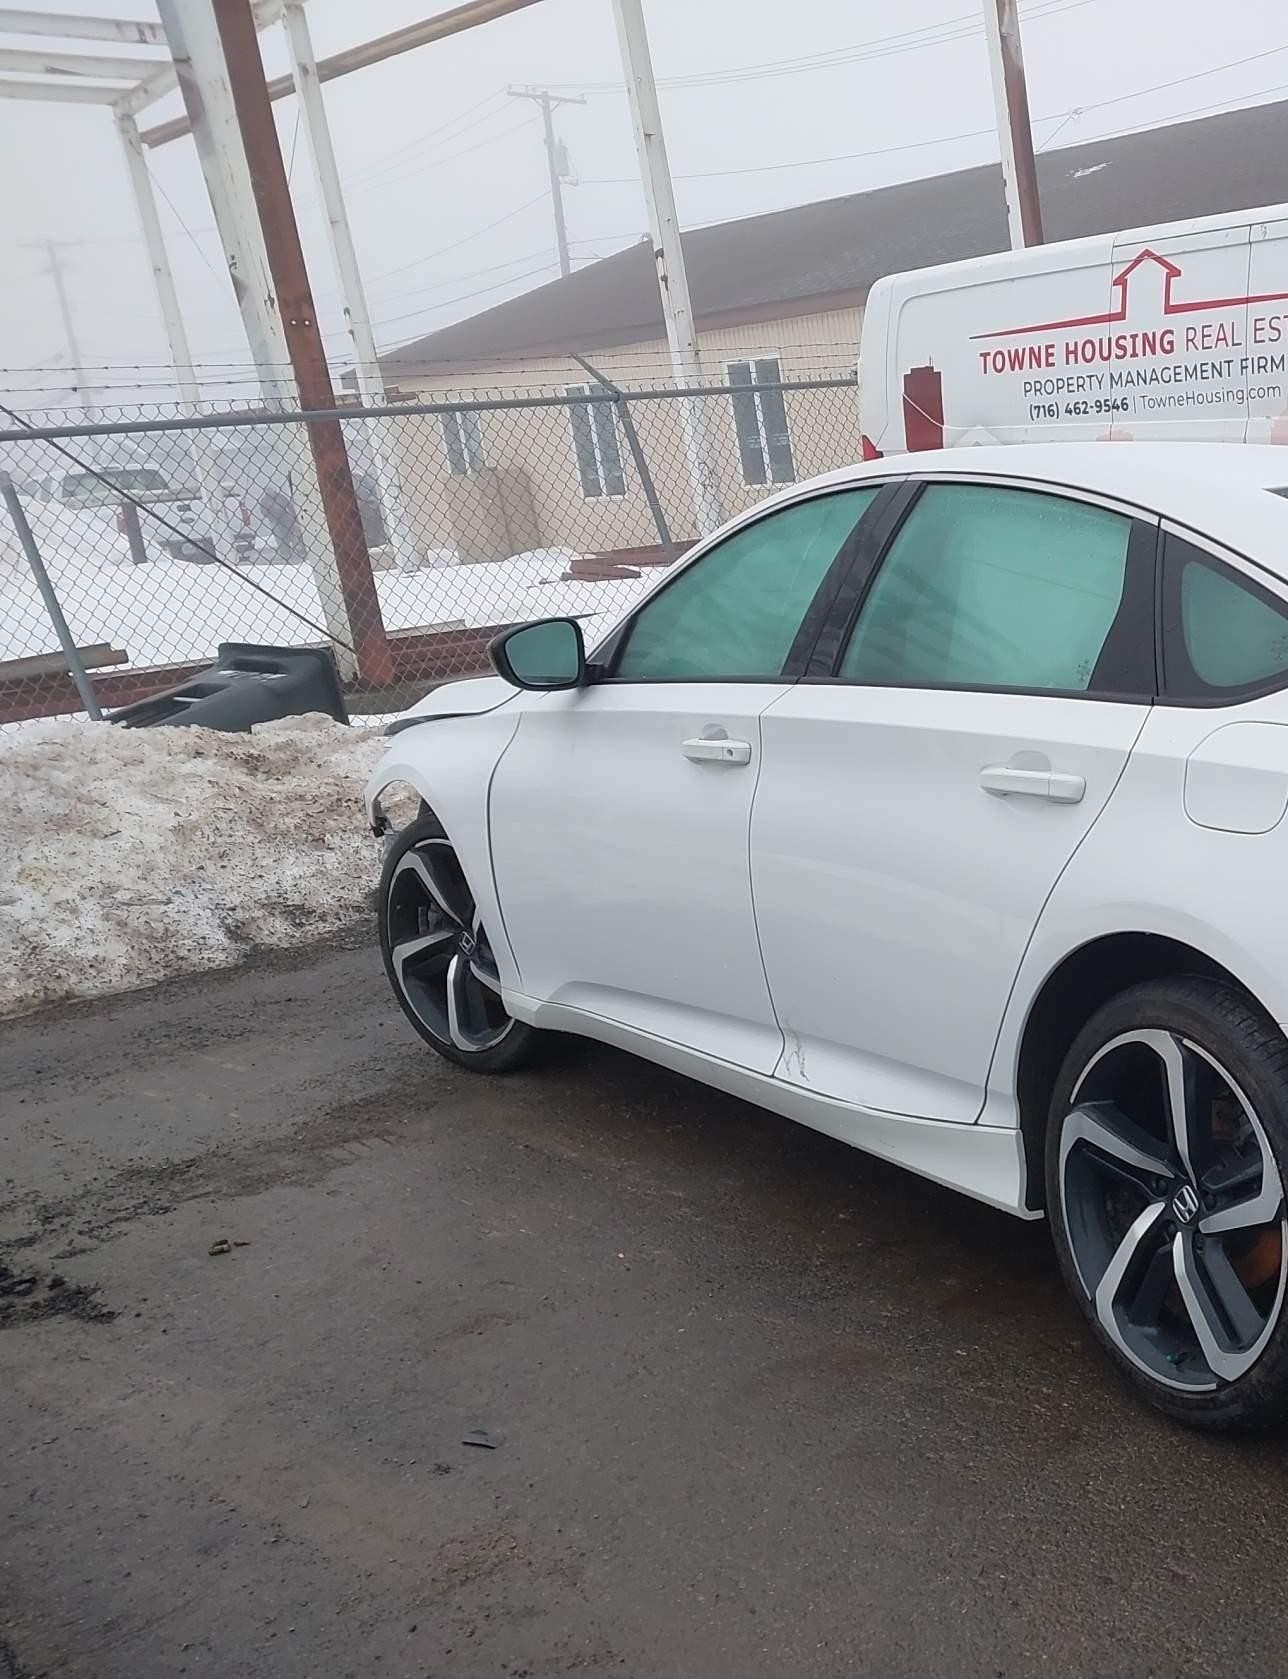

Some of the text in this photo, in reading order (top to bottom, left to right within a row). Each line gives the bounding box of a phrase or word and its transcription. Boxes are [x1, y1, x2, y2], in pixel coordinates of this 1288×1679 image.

[979, 343, 1056, 375] TOWNE
[1065, 329, 1175, 366] HOUSING
[1185, 321, 1242, 352] REAL
[1023, 353, 1286, 398] PROPERTY MANAGEMENT FIRM
[1029, 385, 1281, 421] (716) 462-9546 TowneHousing.com
